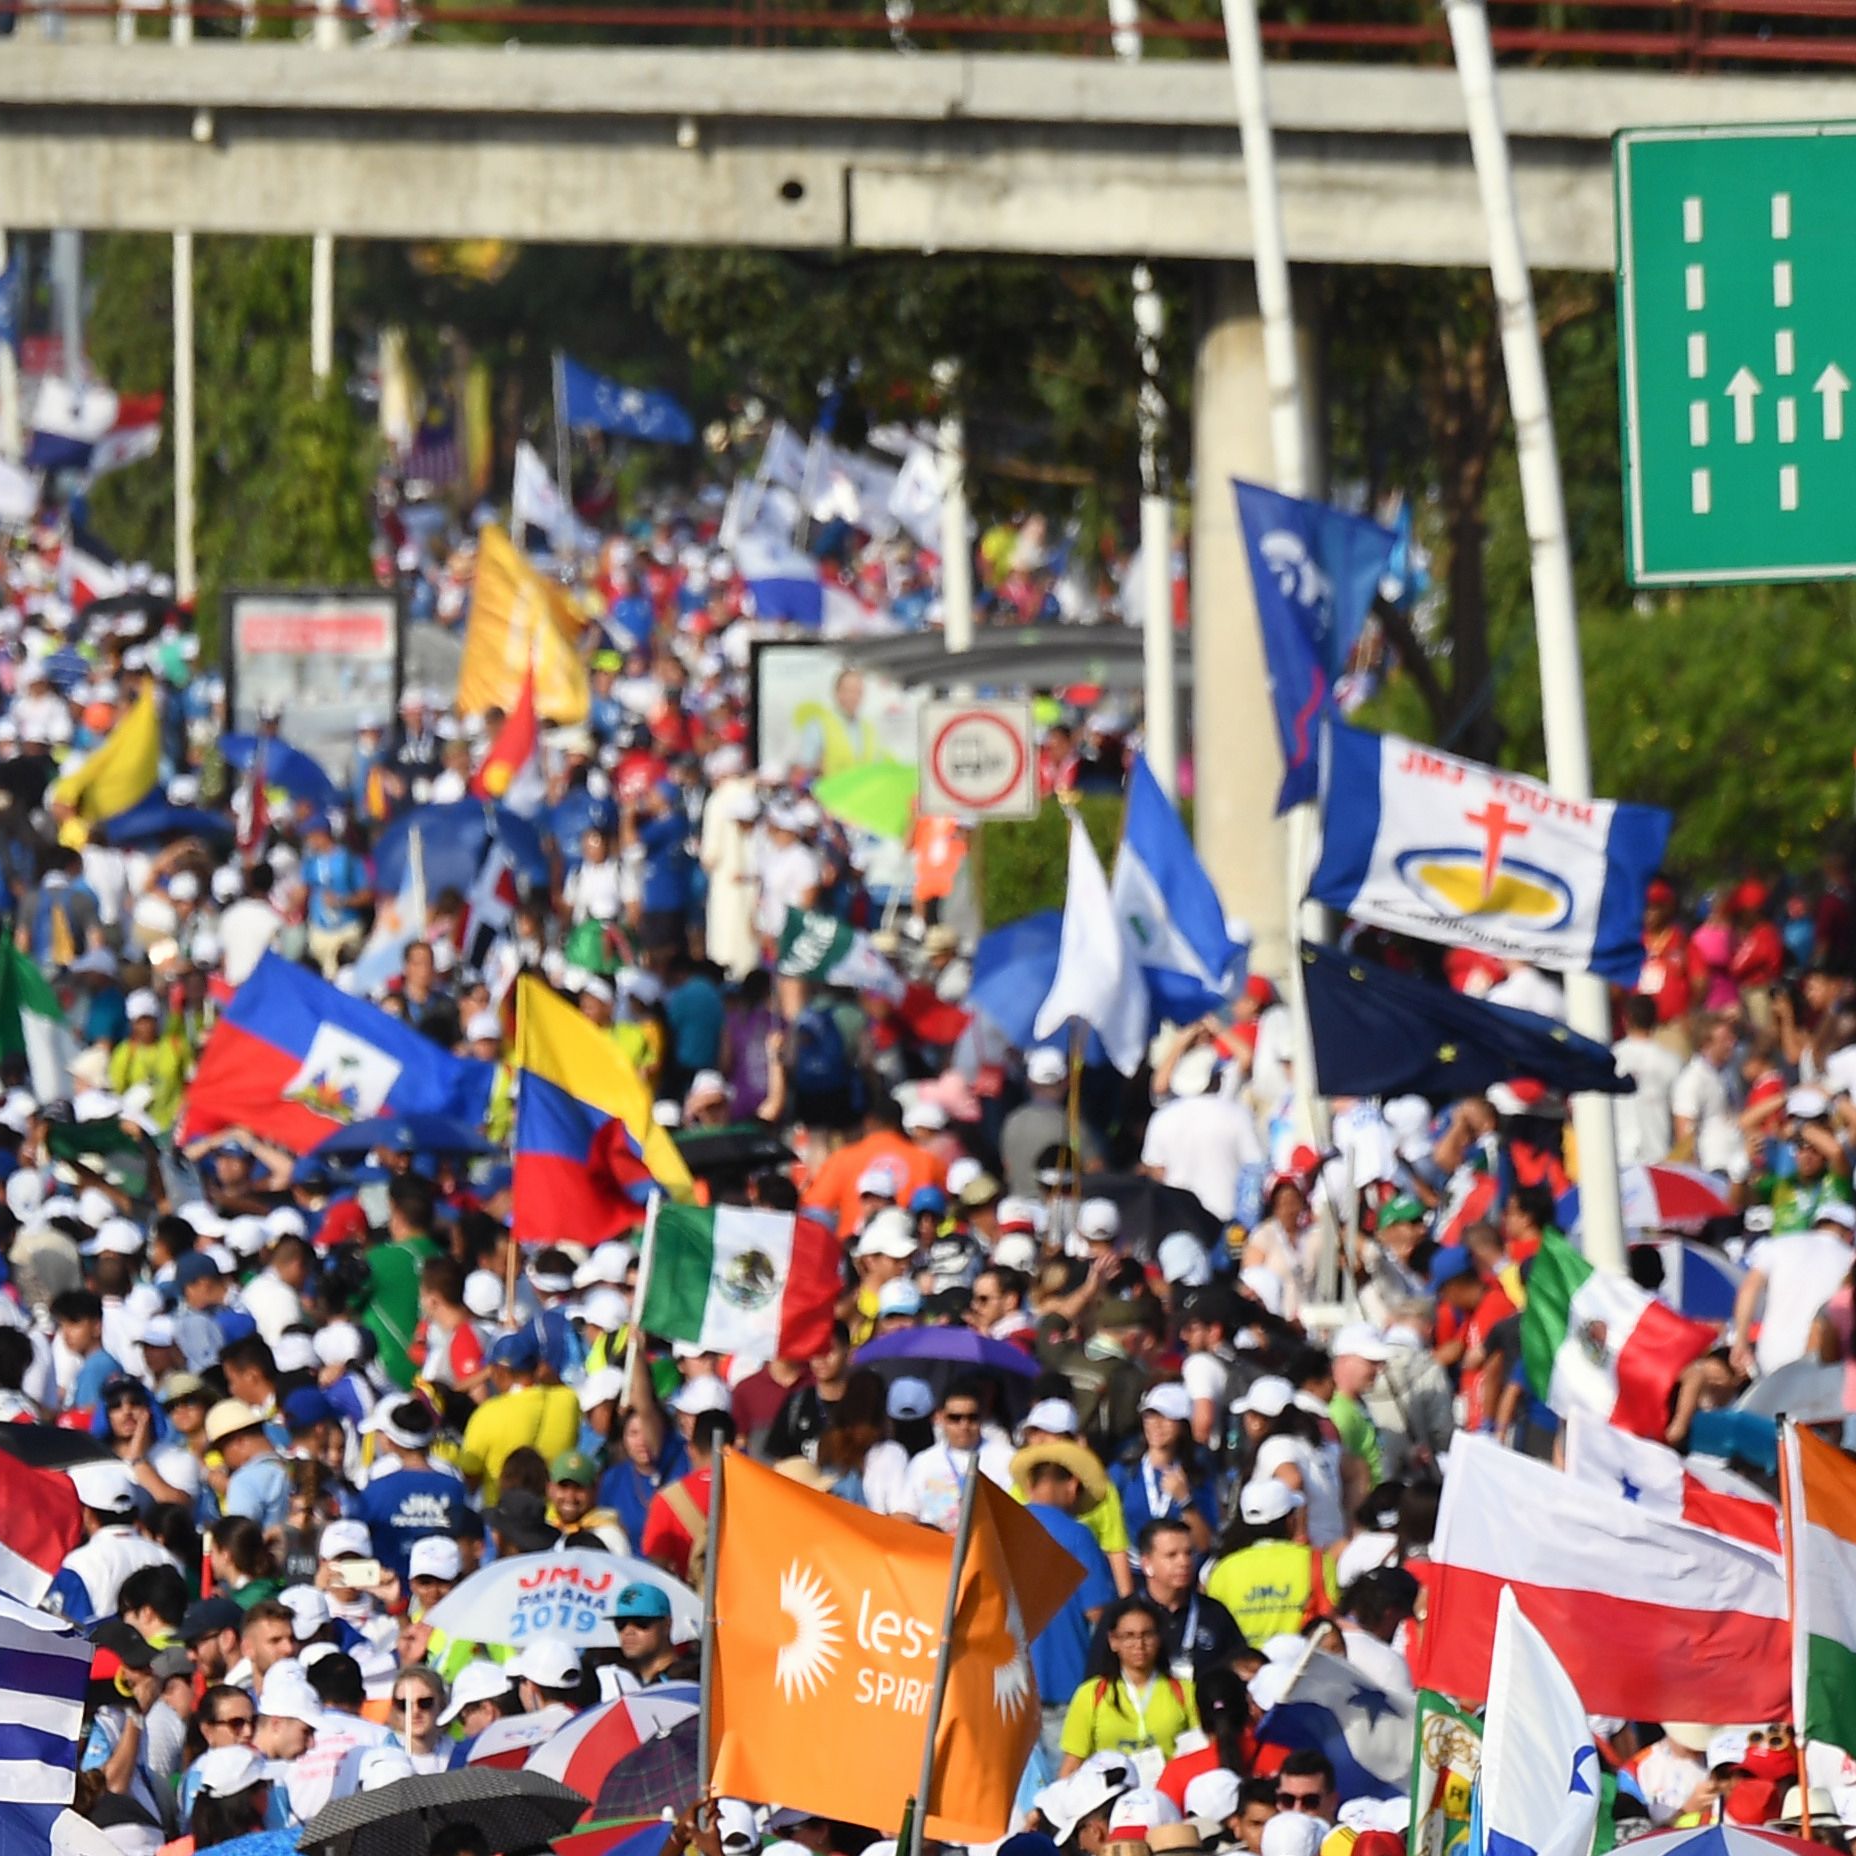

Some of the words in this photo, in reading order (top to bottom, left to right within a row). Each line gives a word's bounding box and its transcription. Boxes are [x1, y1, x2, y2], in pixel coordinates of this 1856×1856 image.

[1490, 775, 1594, 824] YOUTH
[519, 1567, 614, 1595] JMJ
[510, 1609, 598, 1640] 2019
